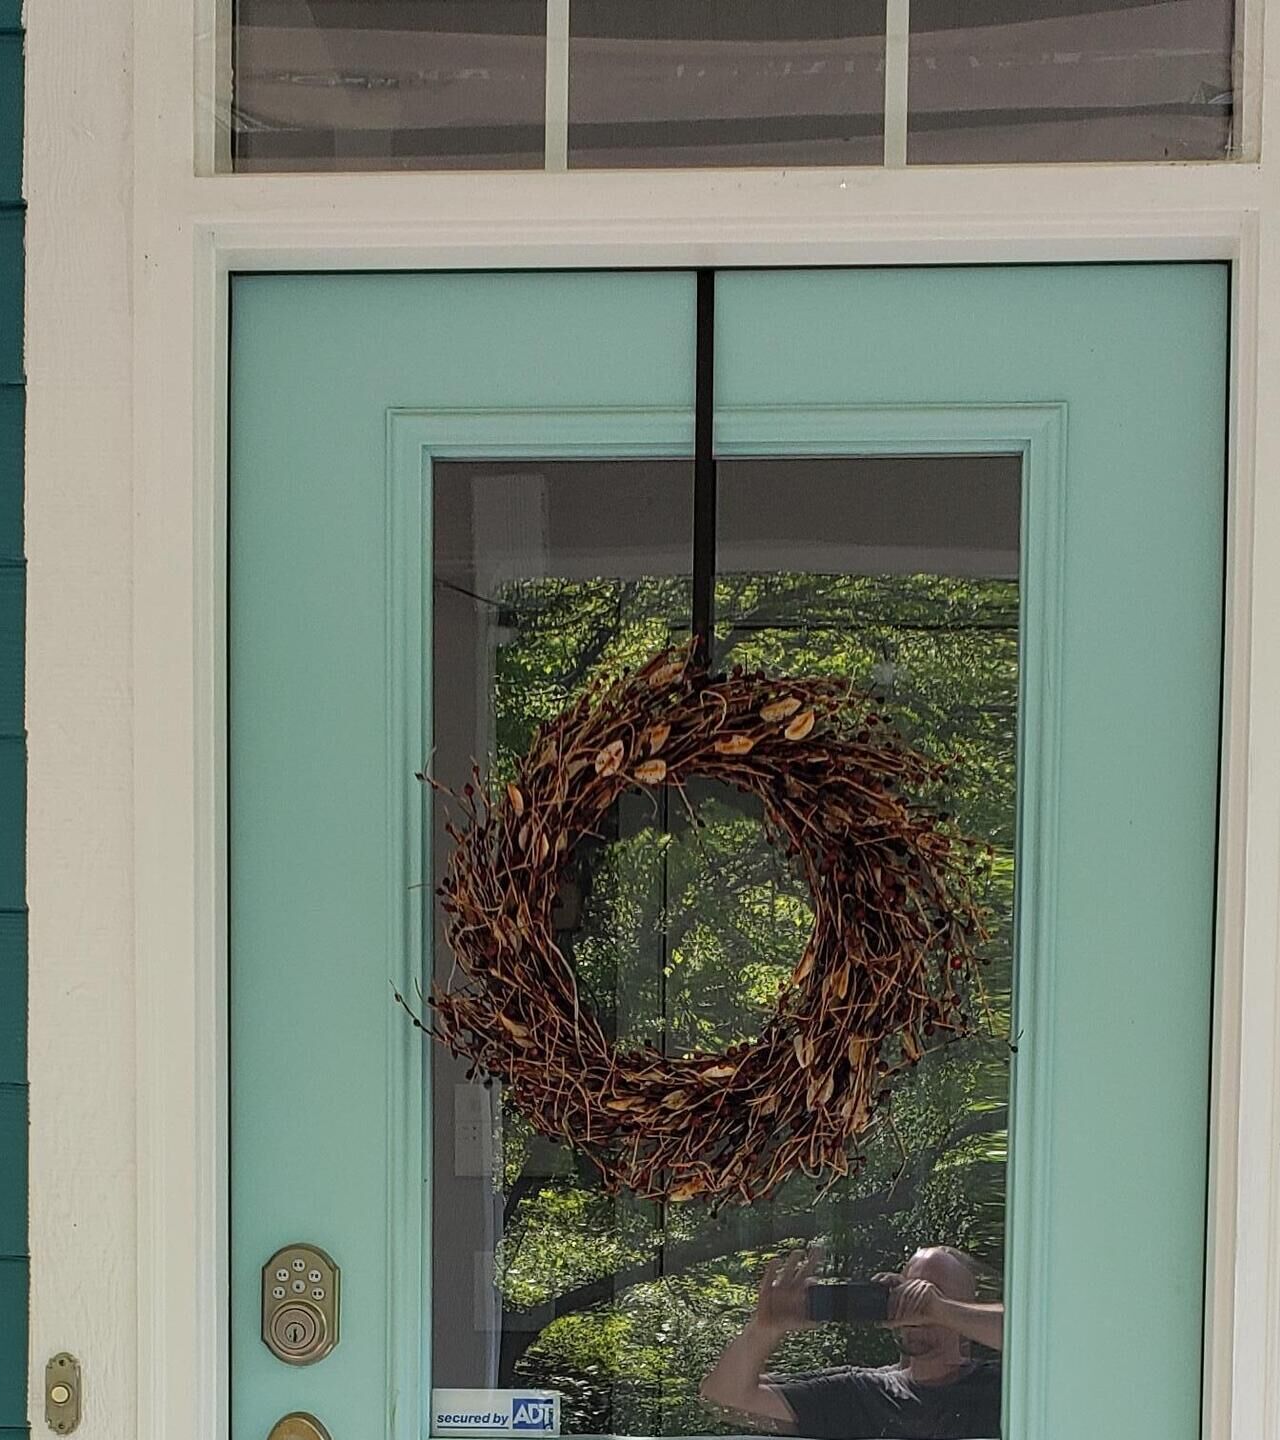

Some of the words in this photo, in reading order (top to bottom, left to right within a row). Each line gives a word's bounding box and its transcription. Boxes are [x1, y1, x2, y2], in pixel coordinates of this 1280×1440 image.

[436, 1412, 490, 1425] secured
[492, 1412, 509, 1427] by
[512, 1402, 553, 1425] ADT
